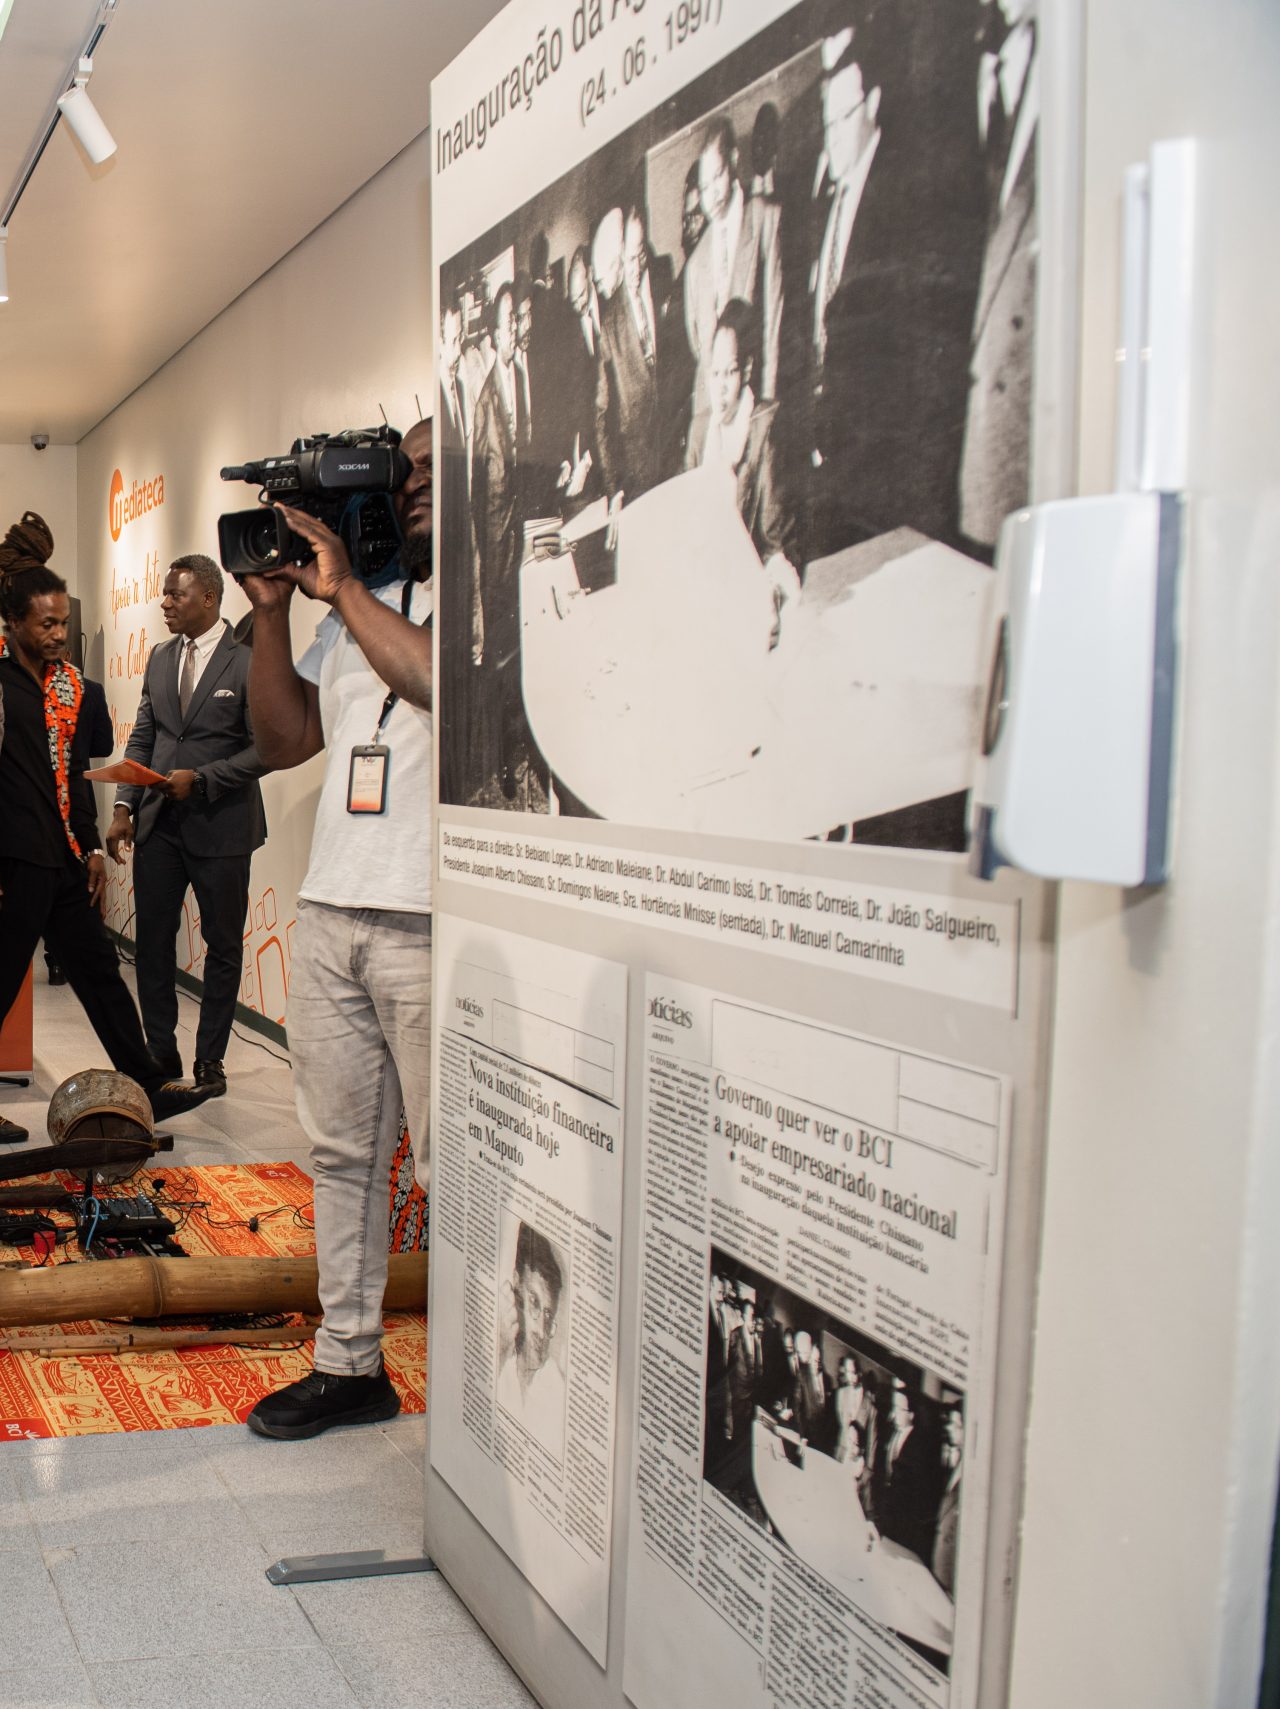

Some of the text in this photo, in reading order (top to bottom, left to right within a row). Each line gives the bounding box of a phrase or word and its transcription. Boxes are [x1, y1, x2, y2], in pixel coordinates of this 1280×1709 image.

[436, 0, 604, 174] Inauguração da
[623, 36, 646, 86] 06
[495, 865, 516, 883] Alberto
[517, 868, 546, 890] Chissano,
[547, 875, 556, 891] Sr.
[558, 877, 592, 899] Domingos
[623, 890, 638, 908] Sra.
[684, 902, 717, 925] Mnisse
[719, 908, 768, 940] (sentada),
[771, 918, 786, 938] Dr.
[789, 923, 832, 951] Manuel
[835, 932, 905, 967] Camarinha
[575, 853, 585, 868] Dr.
[586, 855, 614, 875] Adriano
[616, 859, 655, 884] Maleiane,
[656, 865, 668, 883] Dr.
[670, 868, 695, 889] Abdul
[697, 871, 730, 893] Carimo
[760, 882, 773, 901] Dr.
[776, 884, 812, 909] Tomás
[816, 890, 862, 921] Correia,
[867, 898, 883, 922] Dr.
[888, 903, 921, 929] João
[925, 908, 1000, 947] Salgueiro,
[469, 1059, 613, 1153] Nova instituição financeira
[469, 1088, 559, 1158] é inaugurada hoje
[469, 1122, 523, 1166] em Maputo
[715, 1075, 893, 1168] Governo quer ver o BCI
[714, 1116, 957, 1239] a apoiar empresariado nacional
[828, 1196, 874, 1228] Presidente
[880, 1221, 924, 1252] Chissano
[752, 1177, 800, 1210] inauguração
[836, 1218, 884, 1251] instituição
[886, 1243, 928, 1274] bancária
[5, 1423, 24, 1437] BCI
